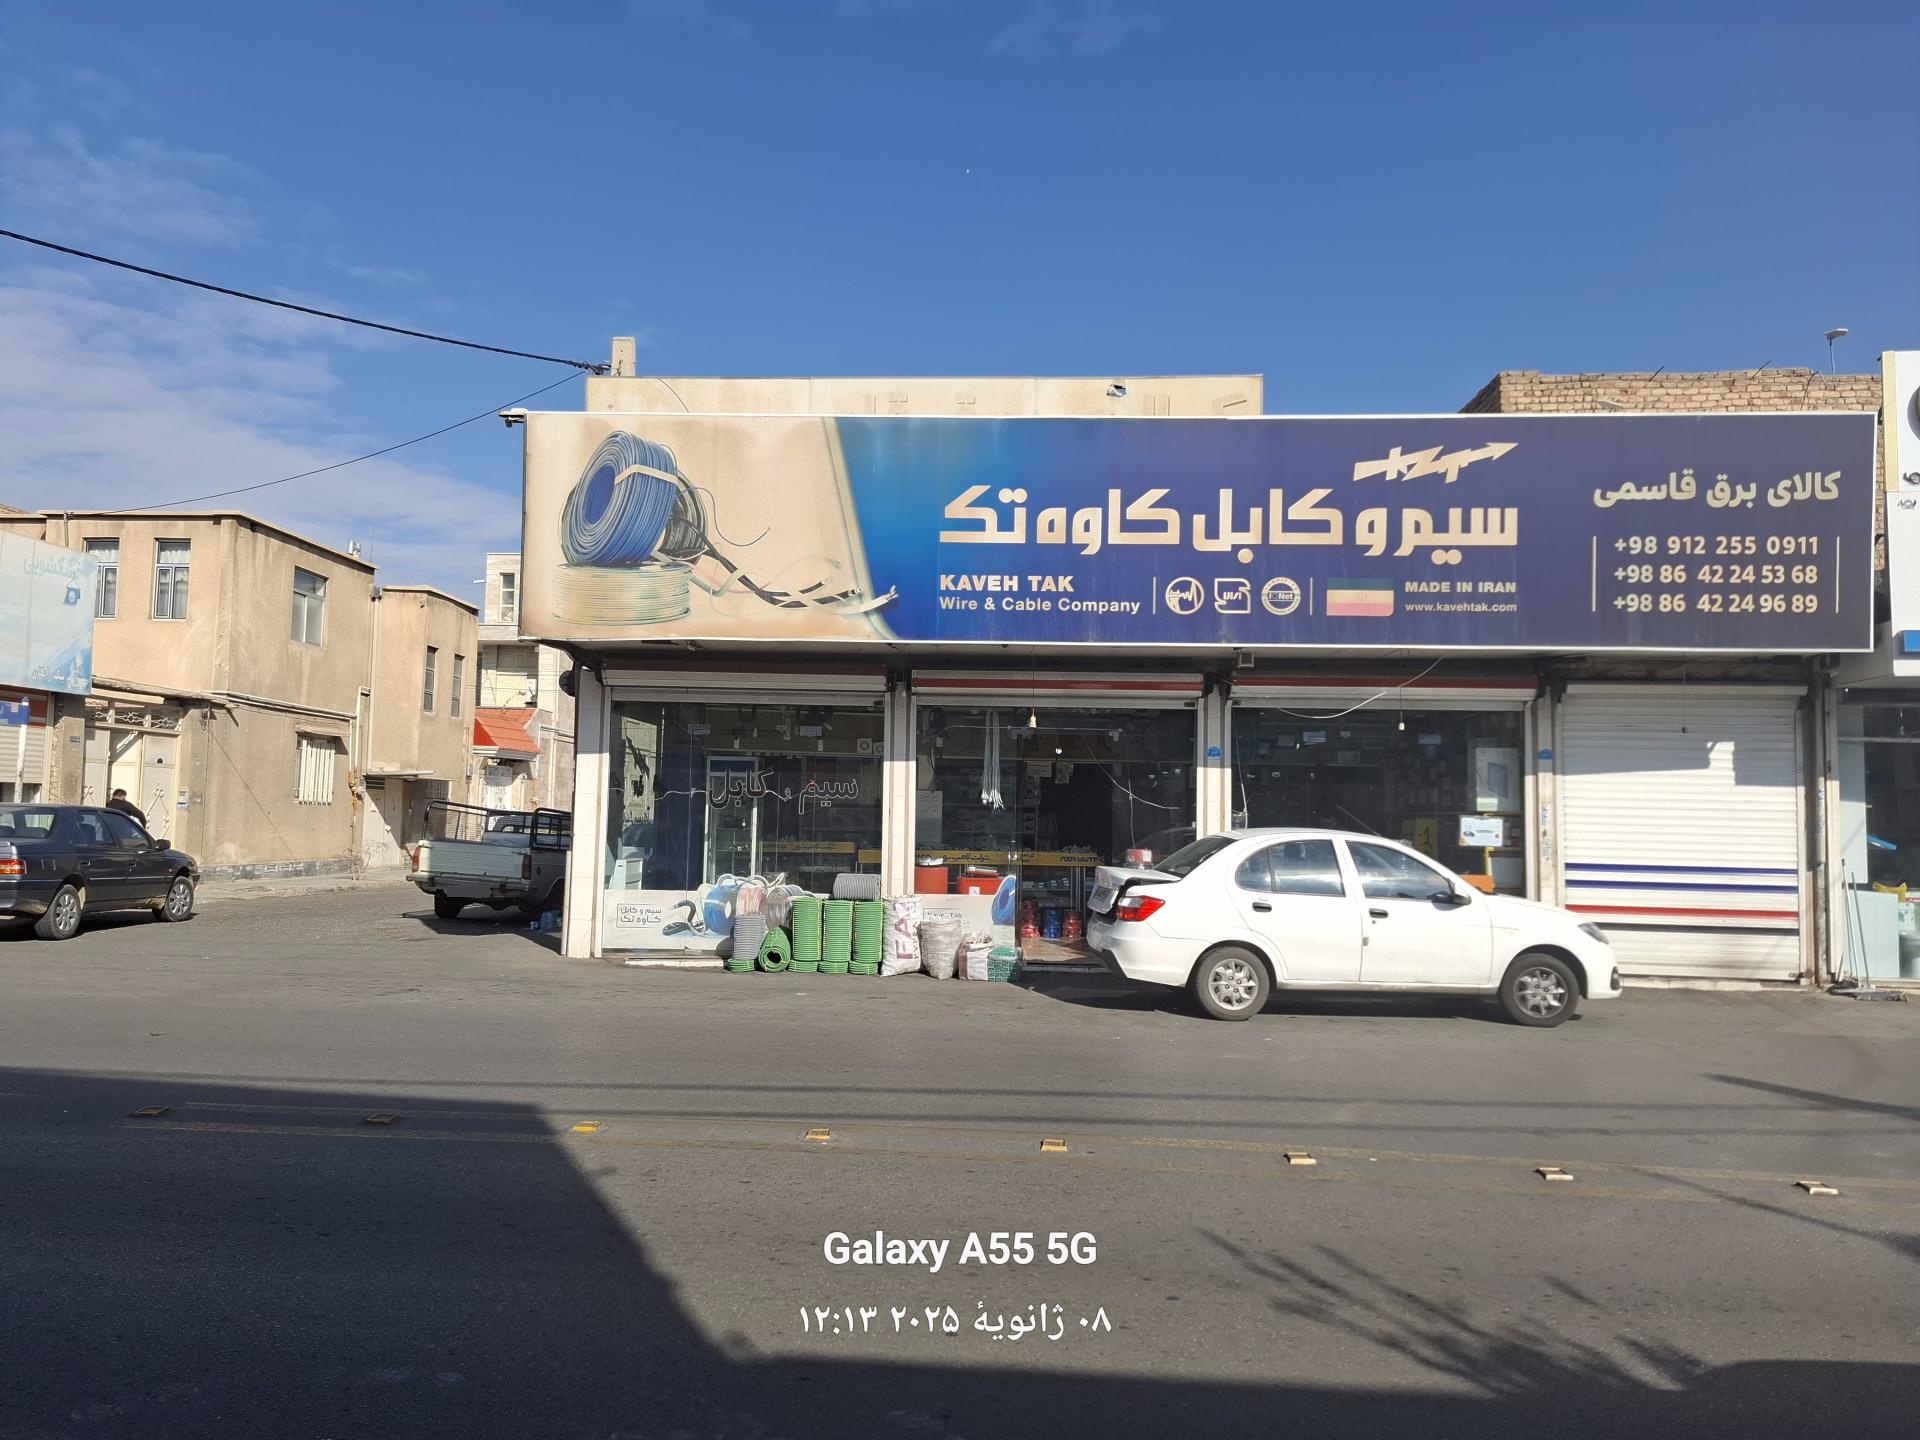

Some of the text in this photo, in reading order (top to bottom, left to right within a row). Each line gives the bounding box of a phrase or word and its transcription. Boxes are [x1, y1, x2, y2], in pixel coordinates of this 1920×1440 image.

[1594, 469, 1841, 508] کالای برق قاسمی
[940, 485, 1517, 564] سیم و کابل کاوه تک
[1615, 536, 1817, 554] +98 912 255 0911
[941, 575, 1074, 591] KAVEH TAK
[1614, 565, 1817, 583] +98 86 42 24 53 68
[1405, 582, 1516, 592] MADE IN IRAN
[940, 597, 1140, 614] Wire & Cable Company
[1406, 603, 1517, 611] www.kavehtak.com
[1614, 594, 1817, 613] +98 86 42 24 96 89
[708, 768, 774, 809] کابل
[799, 779, 858, 814] سیم
